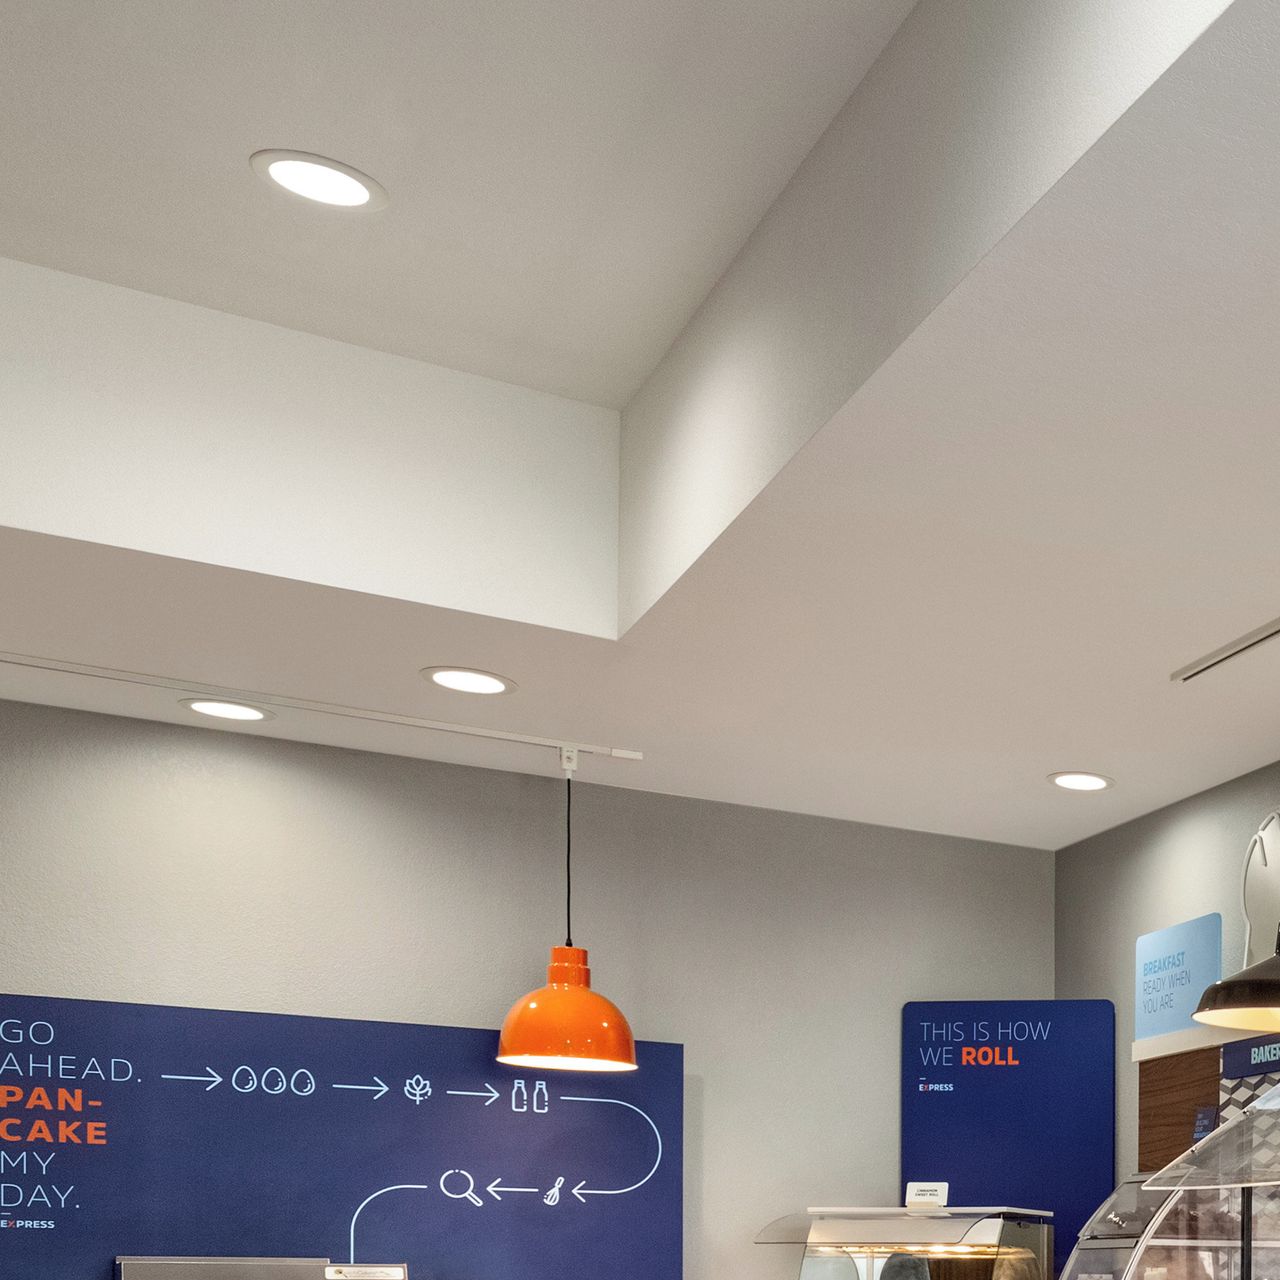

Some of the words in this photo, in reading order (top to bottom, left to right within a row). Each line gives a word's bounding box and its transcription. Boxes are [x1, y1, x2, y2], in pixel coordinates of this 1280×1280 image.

[1144, 951, 1185, 977] BREAKFAST
[1144, 977, 1167, 995] READY
[1168, 969, 1191, 989] WHEN
[1142, 998, 1158, 1014] YOU
[1159, 992, 1174, 1010] ARE
[0, 1019, 54, 1045] GO
[920, 1022, 965, 1042] THIS
[973, 1022, 990, 1041] IS
[998, 1021, 1051, 1041] HOW
[0, 1052, 142, 1083] AHEAD.
[920, 1047, 953, 1066] WE
[961, 1046, 1020, 1066] ROLL
[0, 1085, 102, 1112] PAN-
[919, 1083, 954, 1091] EXPRESS
[0, 1118, 107, 1145] CAKE
[1, 1151, 56, 1175] MY
[1, 1183, 80, 1208] DAY.
[0, 1219, 55, 1229] EXPRESS
